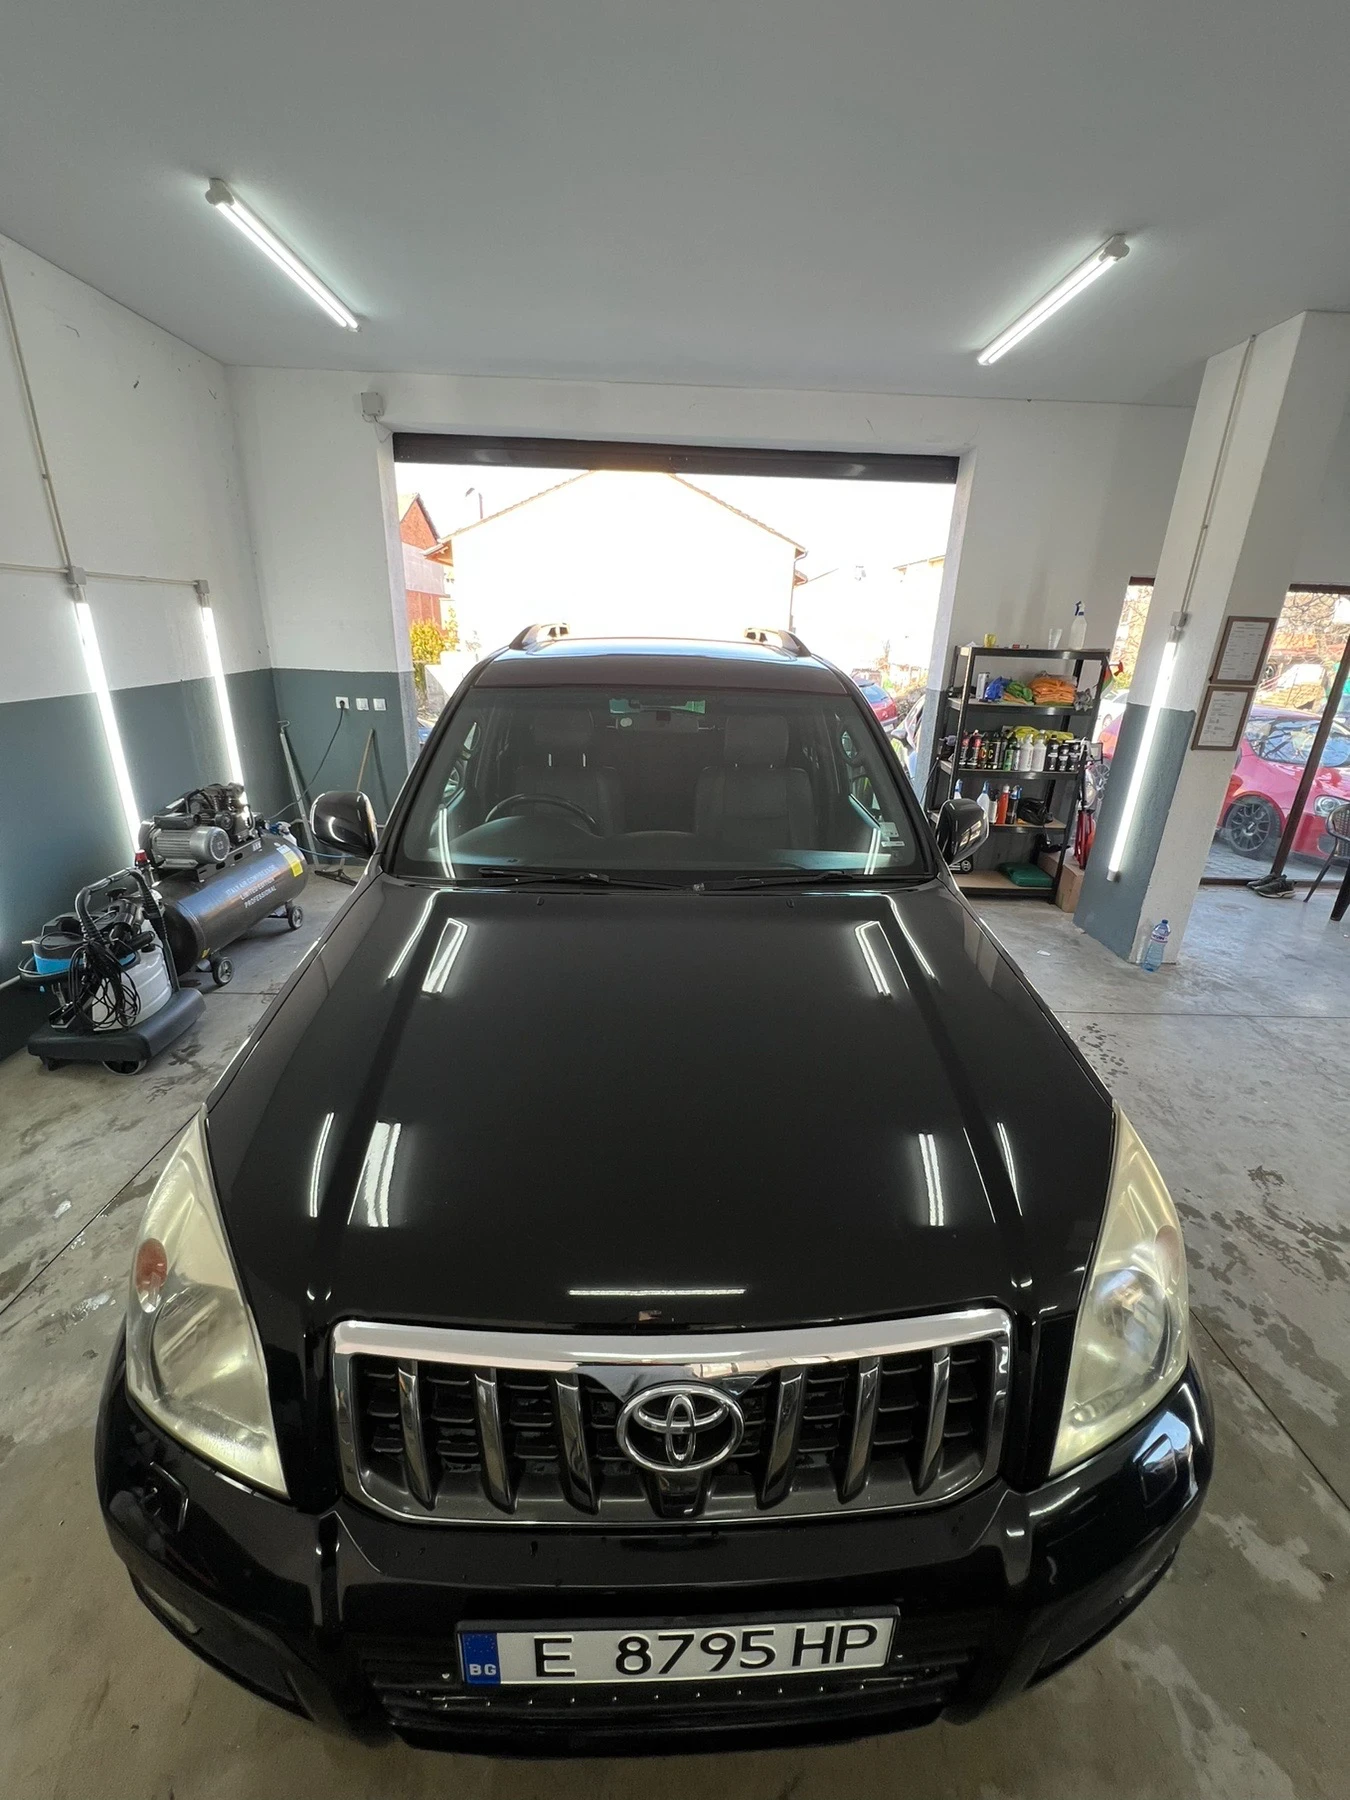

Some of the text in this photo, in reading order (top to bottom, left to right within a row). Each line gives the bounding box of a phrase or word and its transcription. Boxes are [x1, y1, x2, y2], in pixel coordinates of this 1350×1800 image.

[244, 885, 277, 908] PROFESSIONAL
[533, 1622, 878, 1678] E 8795 HP
[469, 1663, 497, 1677] BG
